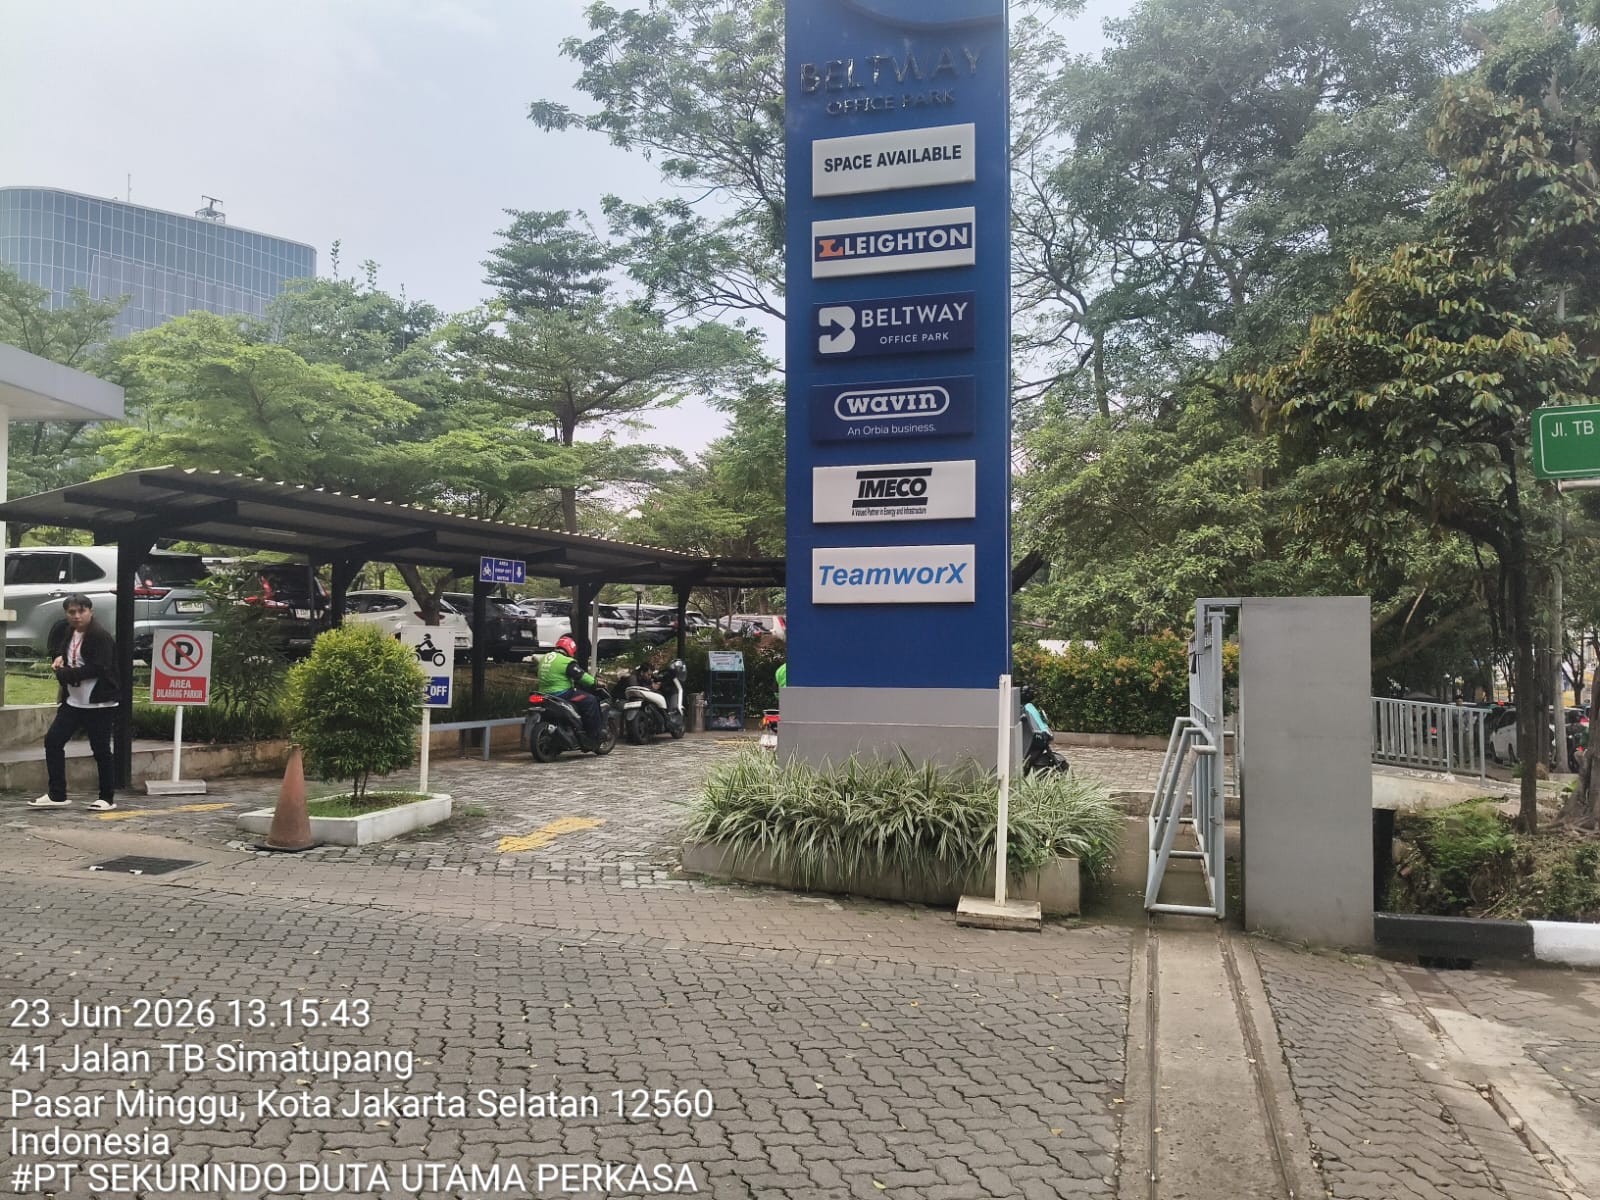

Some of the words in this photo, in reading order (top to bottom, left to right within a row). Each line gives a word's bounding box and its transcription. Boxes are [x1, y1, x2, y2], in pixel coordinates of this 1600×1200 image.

[800, 46, 981, 93] BELTWAY
[825, 95, 895, 114] OFFICE
[901, 88, 956, 108] PARK
[824, 154, 872, 173] SPACE
[877, 144, 962, 168] AVAILABLE
[844, 226, 969, 256] LEIGHTON
[861, 302, 968, 328] BELTWAY
[879, 333, 918, 345] OFFICE
[921, 331, 949, 342] PARK
[846, 392, 937, 414] wavin
[847, 426, 861, 436] An
[863, 424, 889, 435] Orbia
[891, 423, 936, 434] business.
[1551, 421, 1567, 438] Jl.
[1572, 420, 1594, 436] TB
[858, 478, 927, 499] IMECO
[818, 562, 968, 586] TeamworX
[169, 679, 192, 689] AREA
[430, 685, 448, 697] OFF
